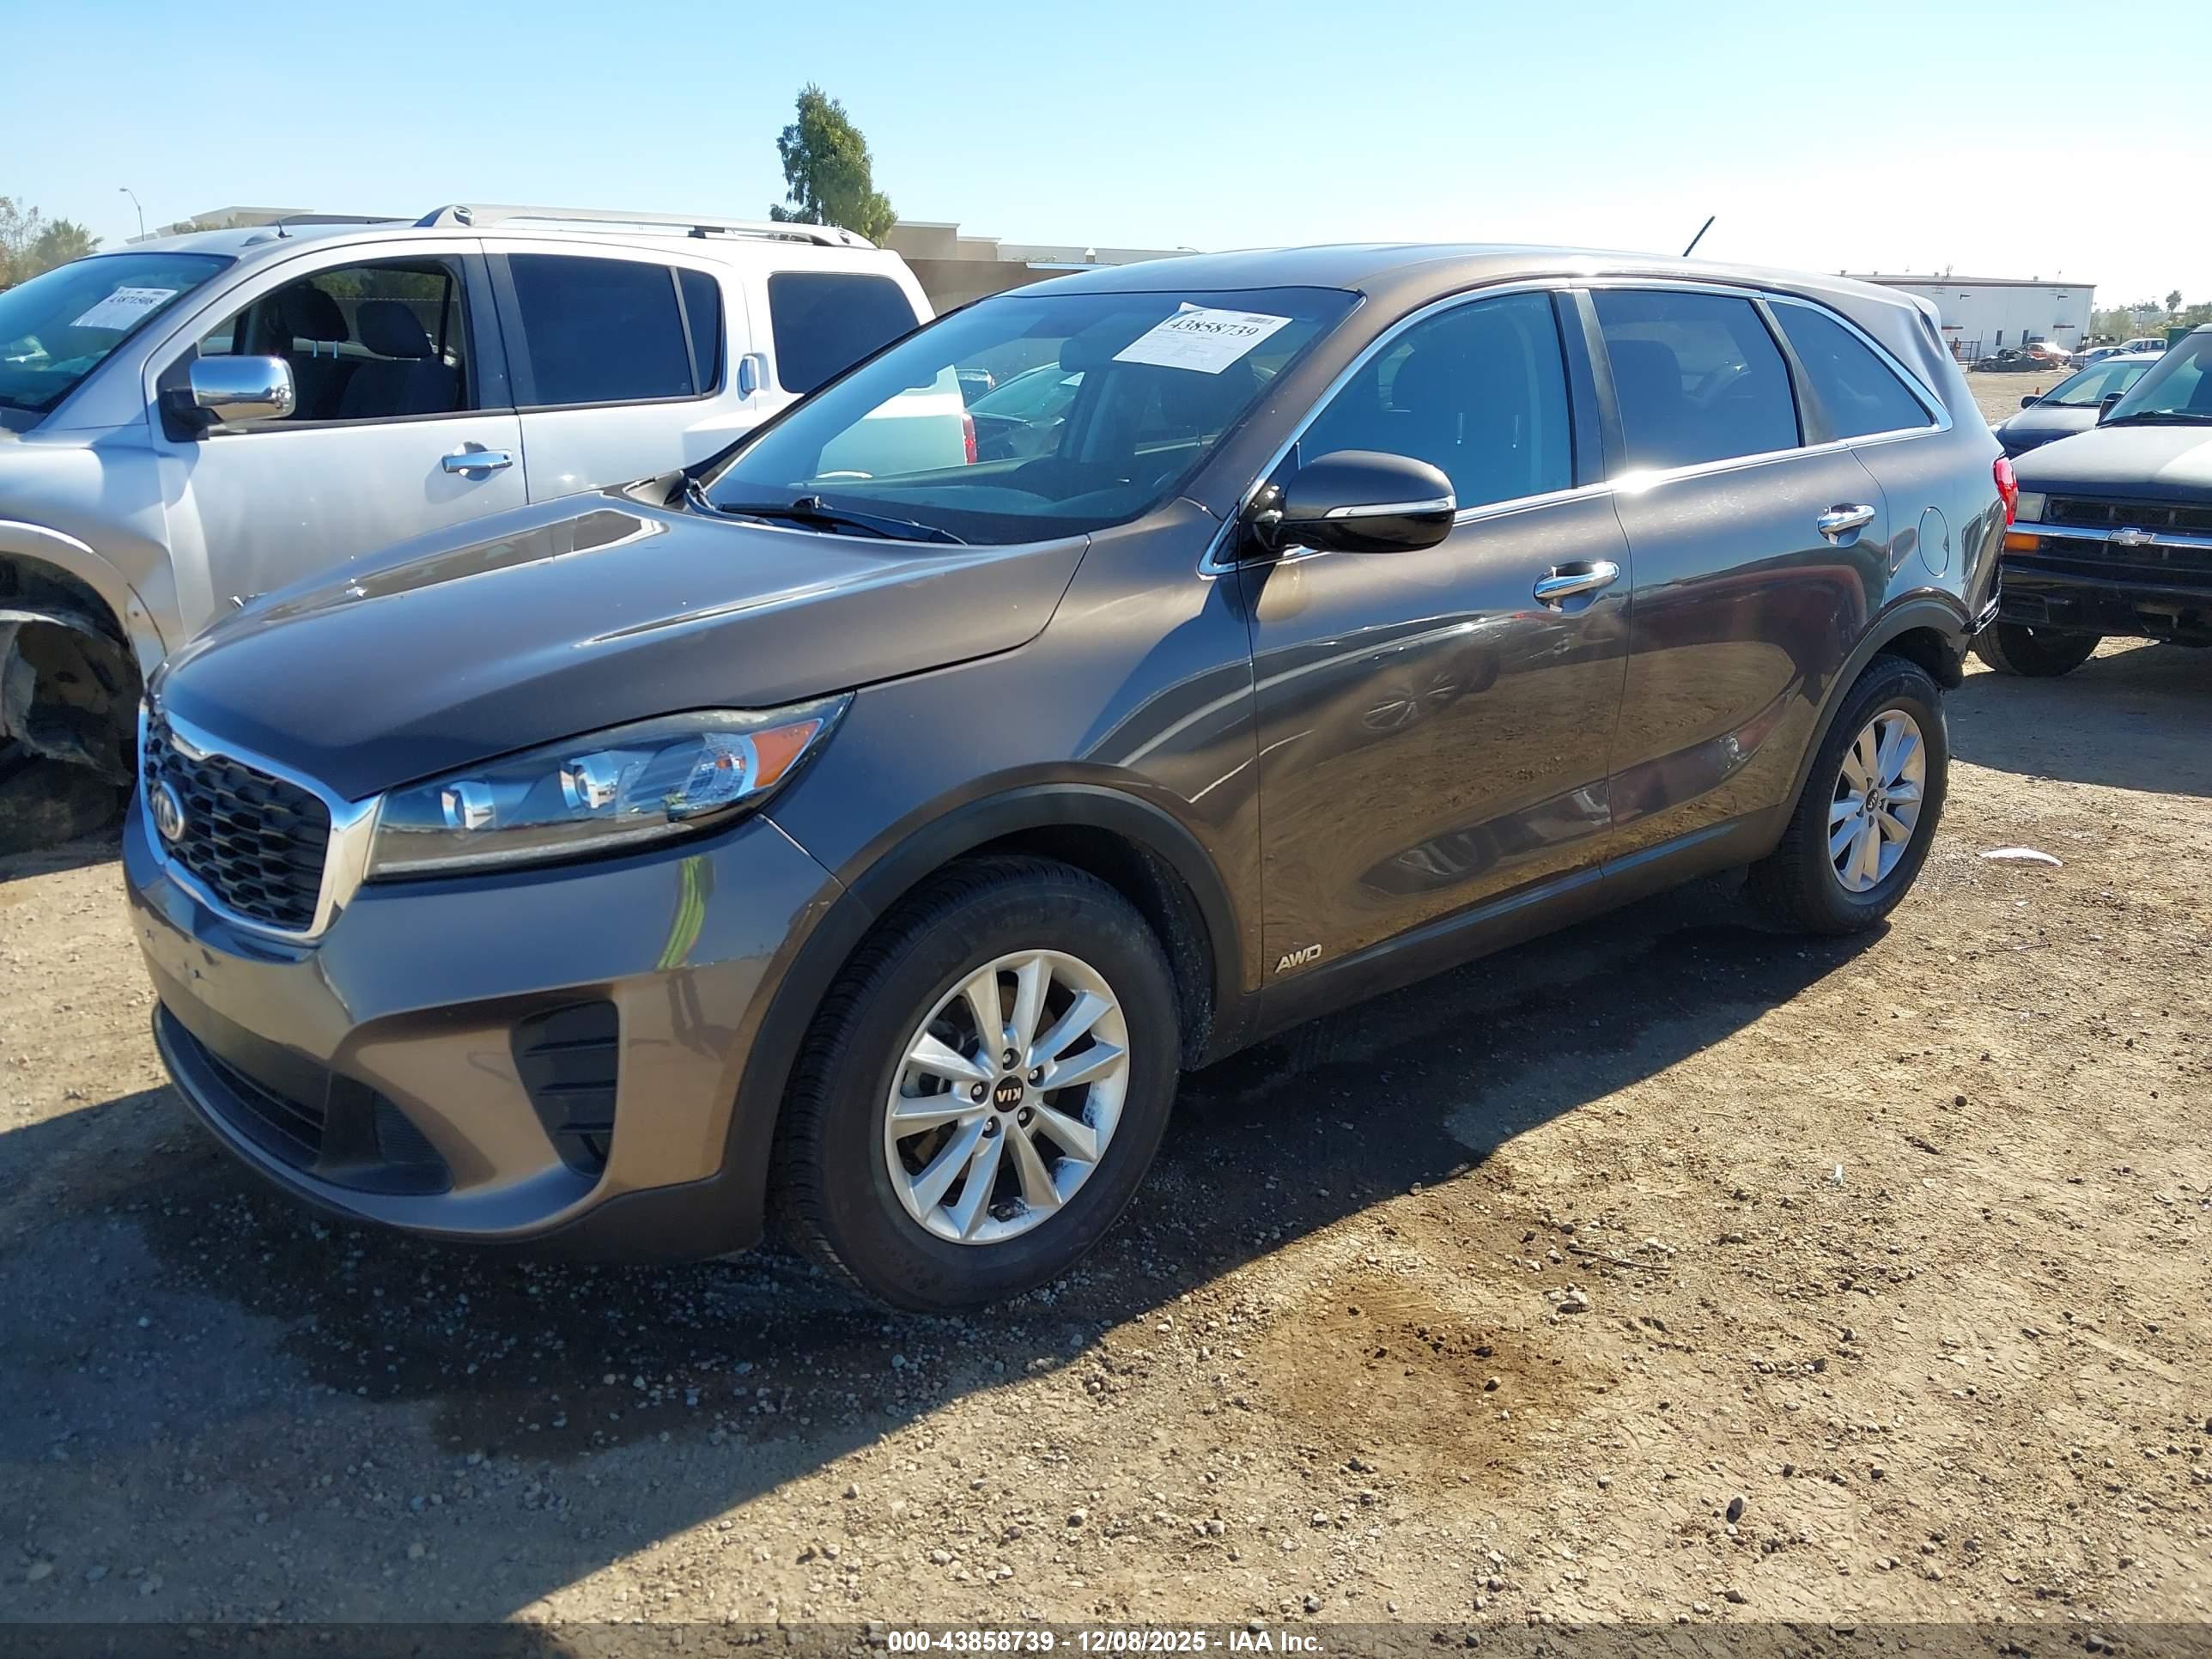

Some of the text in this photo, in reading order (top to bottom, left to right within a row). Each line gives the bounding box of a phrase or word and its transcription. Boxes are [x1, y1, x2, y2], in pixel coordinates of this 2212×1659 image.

[1170, 319, 1259, 337] 43858739
[1274, 944, 1322, 974] AWD
[997, 1087, 1022, 1103] KIA
